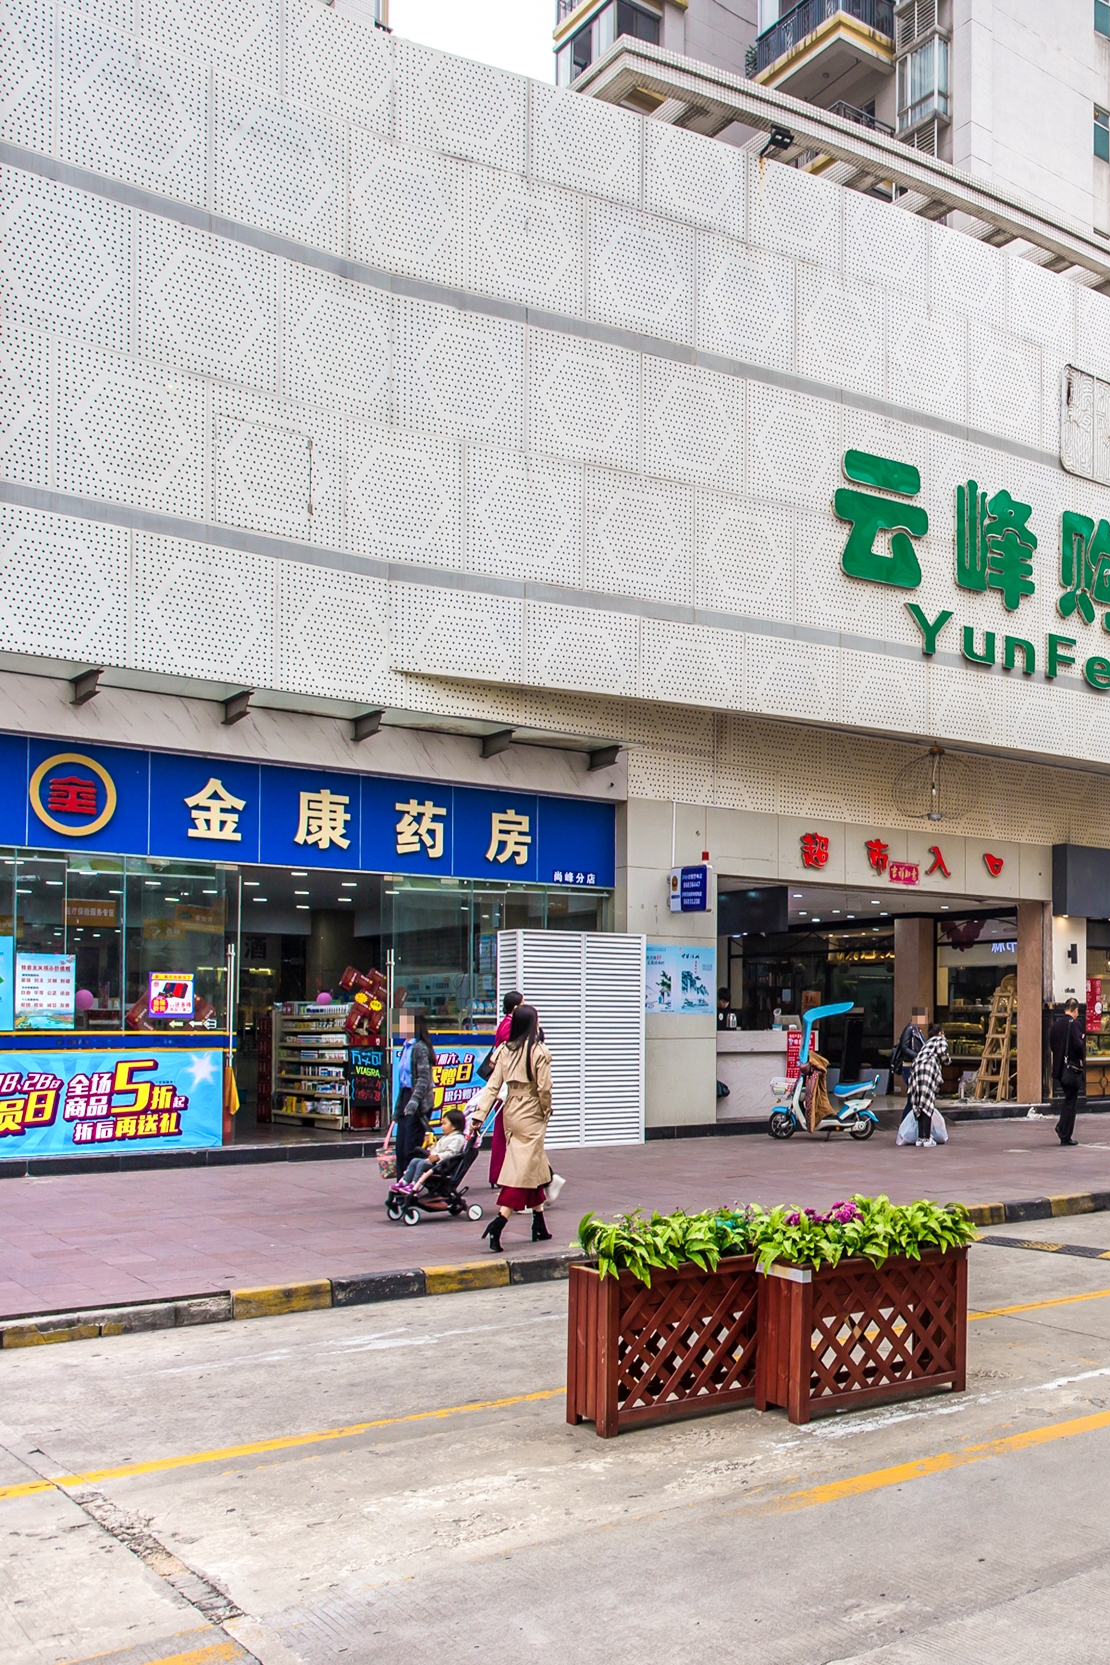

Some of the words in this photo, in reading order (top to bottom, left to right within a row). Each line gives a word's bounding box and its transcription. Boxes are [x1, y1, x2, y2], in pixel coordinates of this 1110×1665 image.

[184, 777, 532, 866] 金康药房
[800, 832, 1004, 877] 超市入口
[553, 870, 596, 884] 尚峰分店
[0, 1073, 61, 1093] 8、28日
[356, 1066, 381, 1078] VIAGRA
[73, 1112, 180, 1142] 折后再送礼
